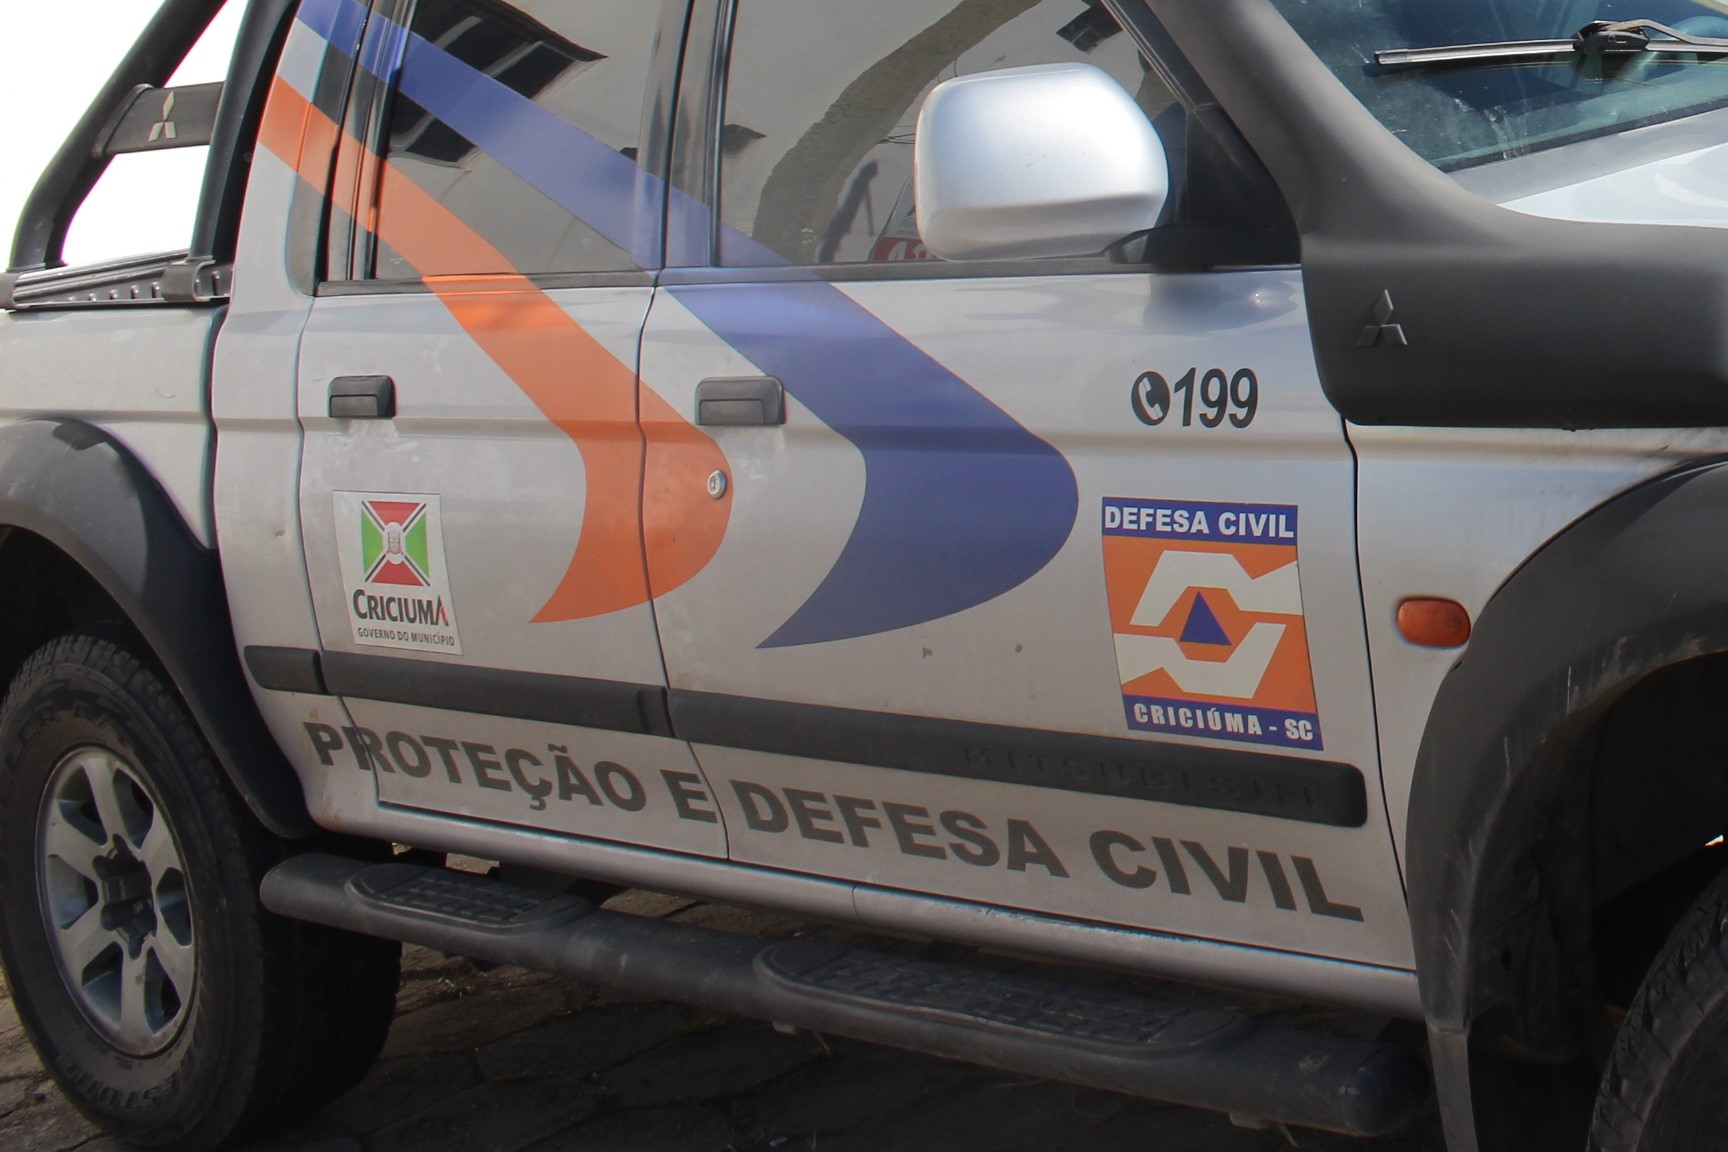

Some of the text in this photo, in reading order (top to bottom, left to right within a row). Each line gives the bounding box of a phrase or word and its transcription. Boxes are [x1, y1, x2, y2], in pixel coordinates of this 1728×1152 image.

[1173, 367, 1259, 429] 199
[1104, 505, 1295, 539] DEFESA CIVIL
[357, 627, 456, 647] GOVERNO DO MUNICÍPIO
[1133, 703, 1263, 737] CRICIÚMA
[1284, 718, 1314, 741] SC
[303, 721, 1365, 923] PROTEÇÃO E DEFESA CIVIL
